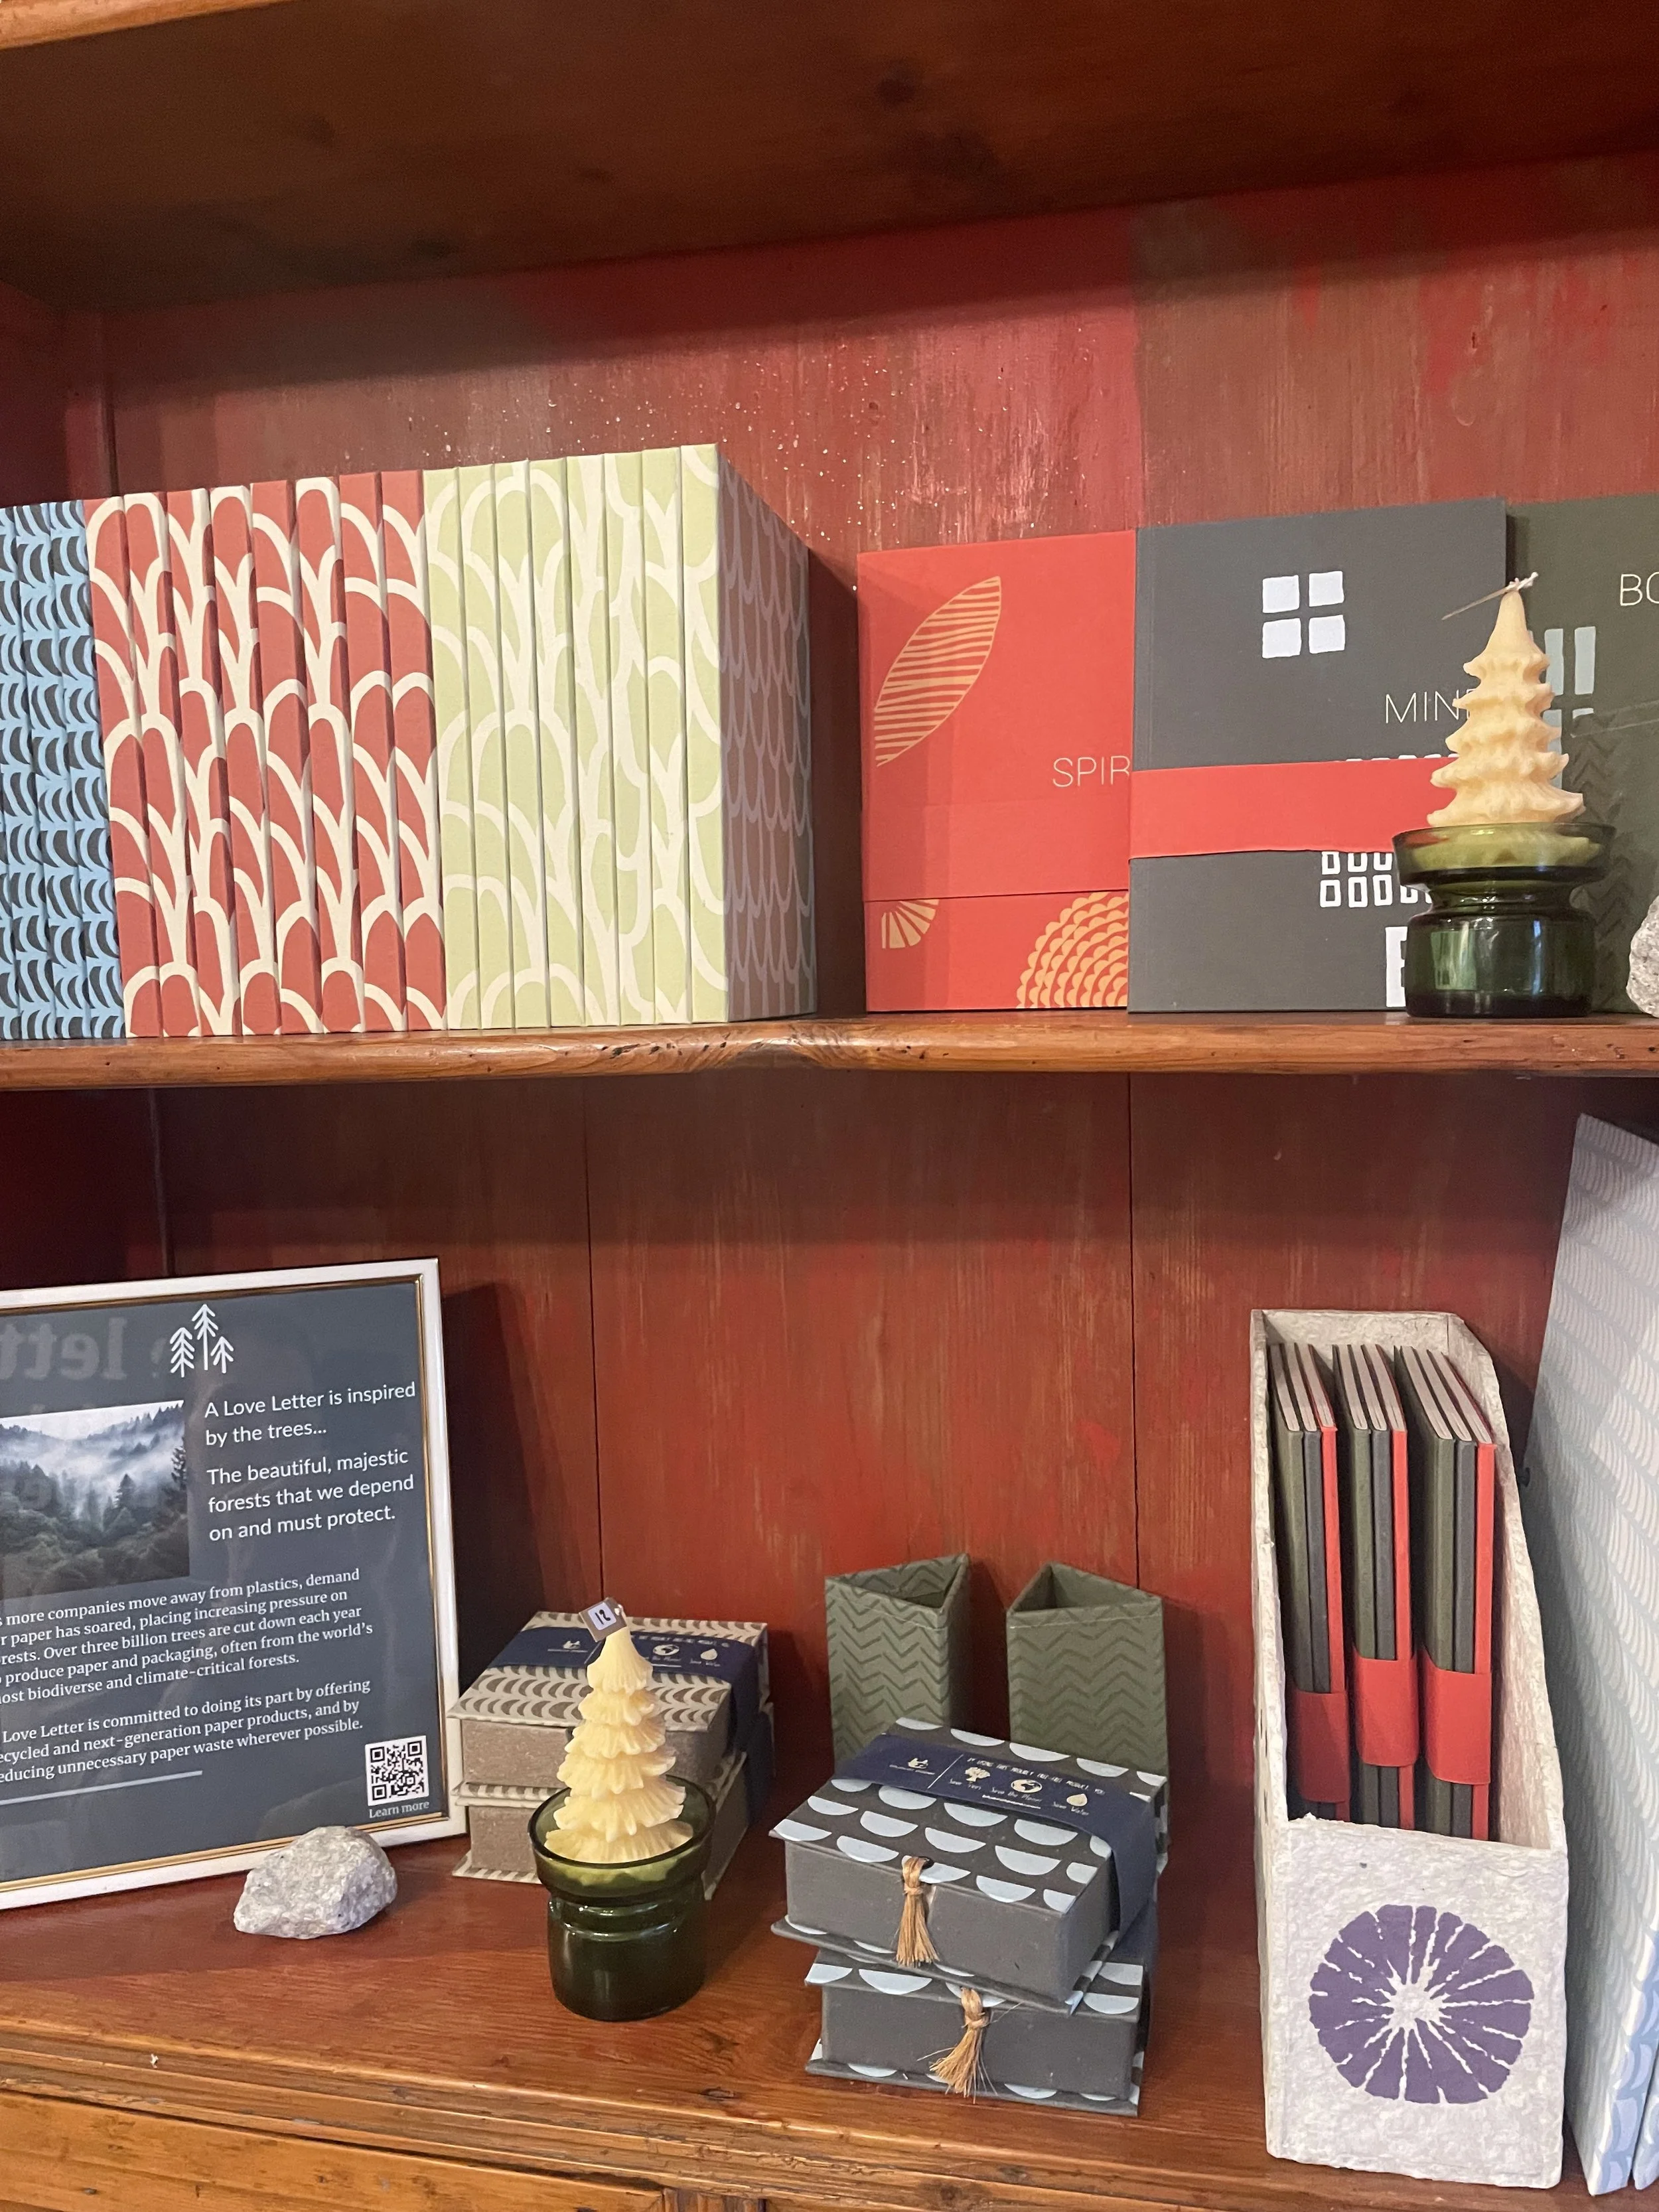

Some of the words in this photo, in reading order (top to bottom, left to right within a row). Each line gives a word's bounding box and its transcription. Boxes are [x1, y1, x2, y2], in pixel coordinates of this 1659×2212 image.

[1386, 688, 1476, 723] MIN
[1052, 755, 1130, 787] SPIR
[204, 1402, 219, 1418] A
[224, 1401, 265, 1416] Love
[272, 1394, 324, 1411] Letter
[329, 1390, 342, 1405] is
[348, 1381, 415, 1404] inspired
[206, 1430, 228, 1447] by
[232, 1426, 262, 1442] the
[267, 1424, 326, 1438] trees...
[206, 1468, 242, 1485] The
[248, 1457, 331, 1481] beautiful,
[337, 1449, 408, 1471] majestic
[208, 1493, 270, 1512] forests
[275, 1487, 313, 1505] that
[317, 1487, 343, 1500] we
[348, 1474, 413, 1497] depend
[210, 1528, 232, 1541] on
[238, 1518, 271, 1538] and
[277, 1514, 322, 1533] must
[327, 1506, 395, 1530] protect.
[6, 1612, 44, 1625] more
[48, 1601, 125, 1619] companies
[129, 1596, 167, 1609] move
[169, 1591, 206, 1604] away
[210, 1586, 243, 1599] from
[247, 1578, 302, 1597] plastics,
[306, 1568, 359, 1586] demand
[0, 1651, 40, 1664] rests.
[43, 1646, 77, 1659] Over
[81, 1641, 119, 1654] three
[121, 1633, 168, 1649] billion
[171, 1629, 206, 1643] trees
[208, 1626, 230, 1637] are
[234, 1621, 255, 1633] cut
[258, 1617, 296, 1630] down
[299, 1609, 330, 1624] each
[332, 1608, 362, 1623] year
[11, 1630, 52, 1647] paper
[55, 1626, 80, 1638] has
[84, 1617, 135, 1635] soared,
[139, 1611, 191, 1631] placing
[194, 1601, 267, 1620] increasing
[269, 1593, 327, 1613] pressure
[330, 1591, 347, 1601] on
[0, 1690, 25, 1704] ost
[27, 1682, 102, 1700] biodiverse
[106, 1674, 132, 1689] and
[135, 1657, 245, 1685] climate-critical
[248, 1654, 299, 1669] forests.
[5, 1667, 64, 1687] produce
[67, 1660, 109, 1679] paper
[111, 1654, 139, 1669] and
[141, 1646, 218, 1668] packaging,
[220, 1640, 257, 1654] often
[260, 1635, 294, 1649] from
[298, 1631, 319, 1643] the
[2, 1730, 36, 1743] Love
[40, 1722, 84, 1739] Letter
[88, 1718, 100, 1731] is
[102, 1706, 180, 1728] committed
[184, 1706, 198, 1716] to
[201, 1700, 242, 1714] doing
[244, 1696, 261, 1708] its
[265, 1692, 294, 1708] part
[296, 1688, 313, 1702] by
[316, 1680, 370, 1697] offering
[53, 1739, 80, 1755] and
[84, 1725, 201, 1751] next-generation
[204, 1718, 244, 1736] paper
[247, 1709, 311, 1730] products,
[315, 1701, 340, 1716] and
[343, 1700, 359, 1714] by
[0, 1765, 55, 1783] educing
[58, 1753, 147, 1774] unnecessary
[150, 1745, 190, 1763] paper
[192, 1739, 234, 1753] waste
[236, 1729, 301, 1747] wherever
[304, 1718, 362, 1740] possible.
[369, 1806, 399, 1818] Learn
[401, 1800, 429, 1813] more
